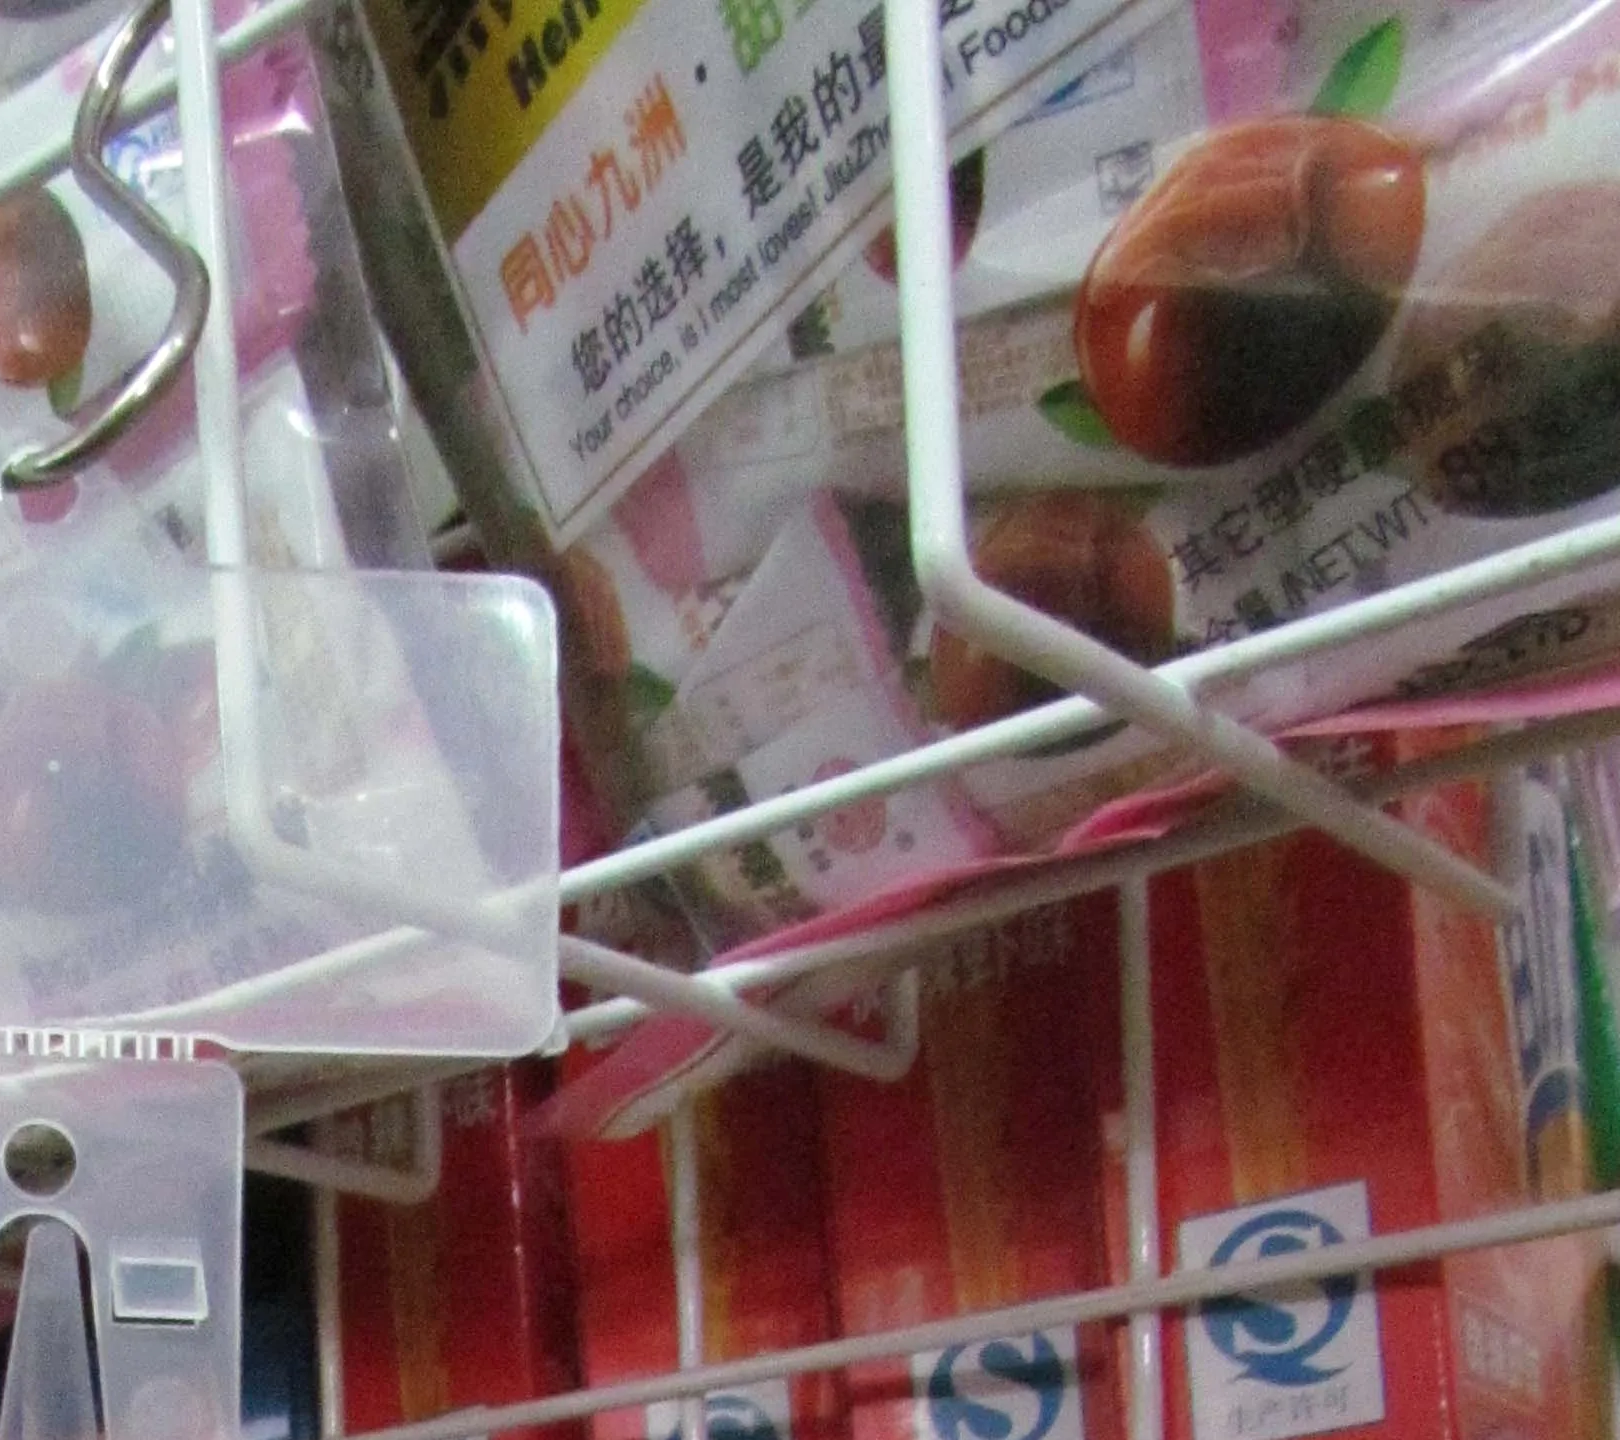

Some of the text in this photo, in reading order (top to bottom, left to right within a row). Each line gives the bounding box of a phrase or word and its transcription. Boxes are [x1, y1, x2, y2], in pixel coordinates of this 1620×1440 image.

[499, 72, 687, 336] 同心九洲
[569, 416, 614, 461] Your
[708, 254, 760, 324] most
